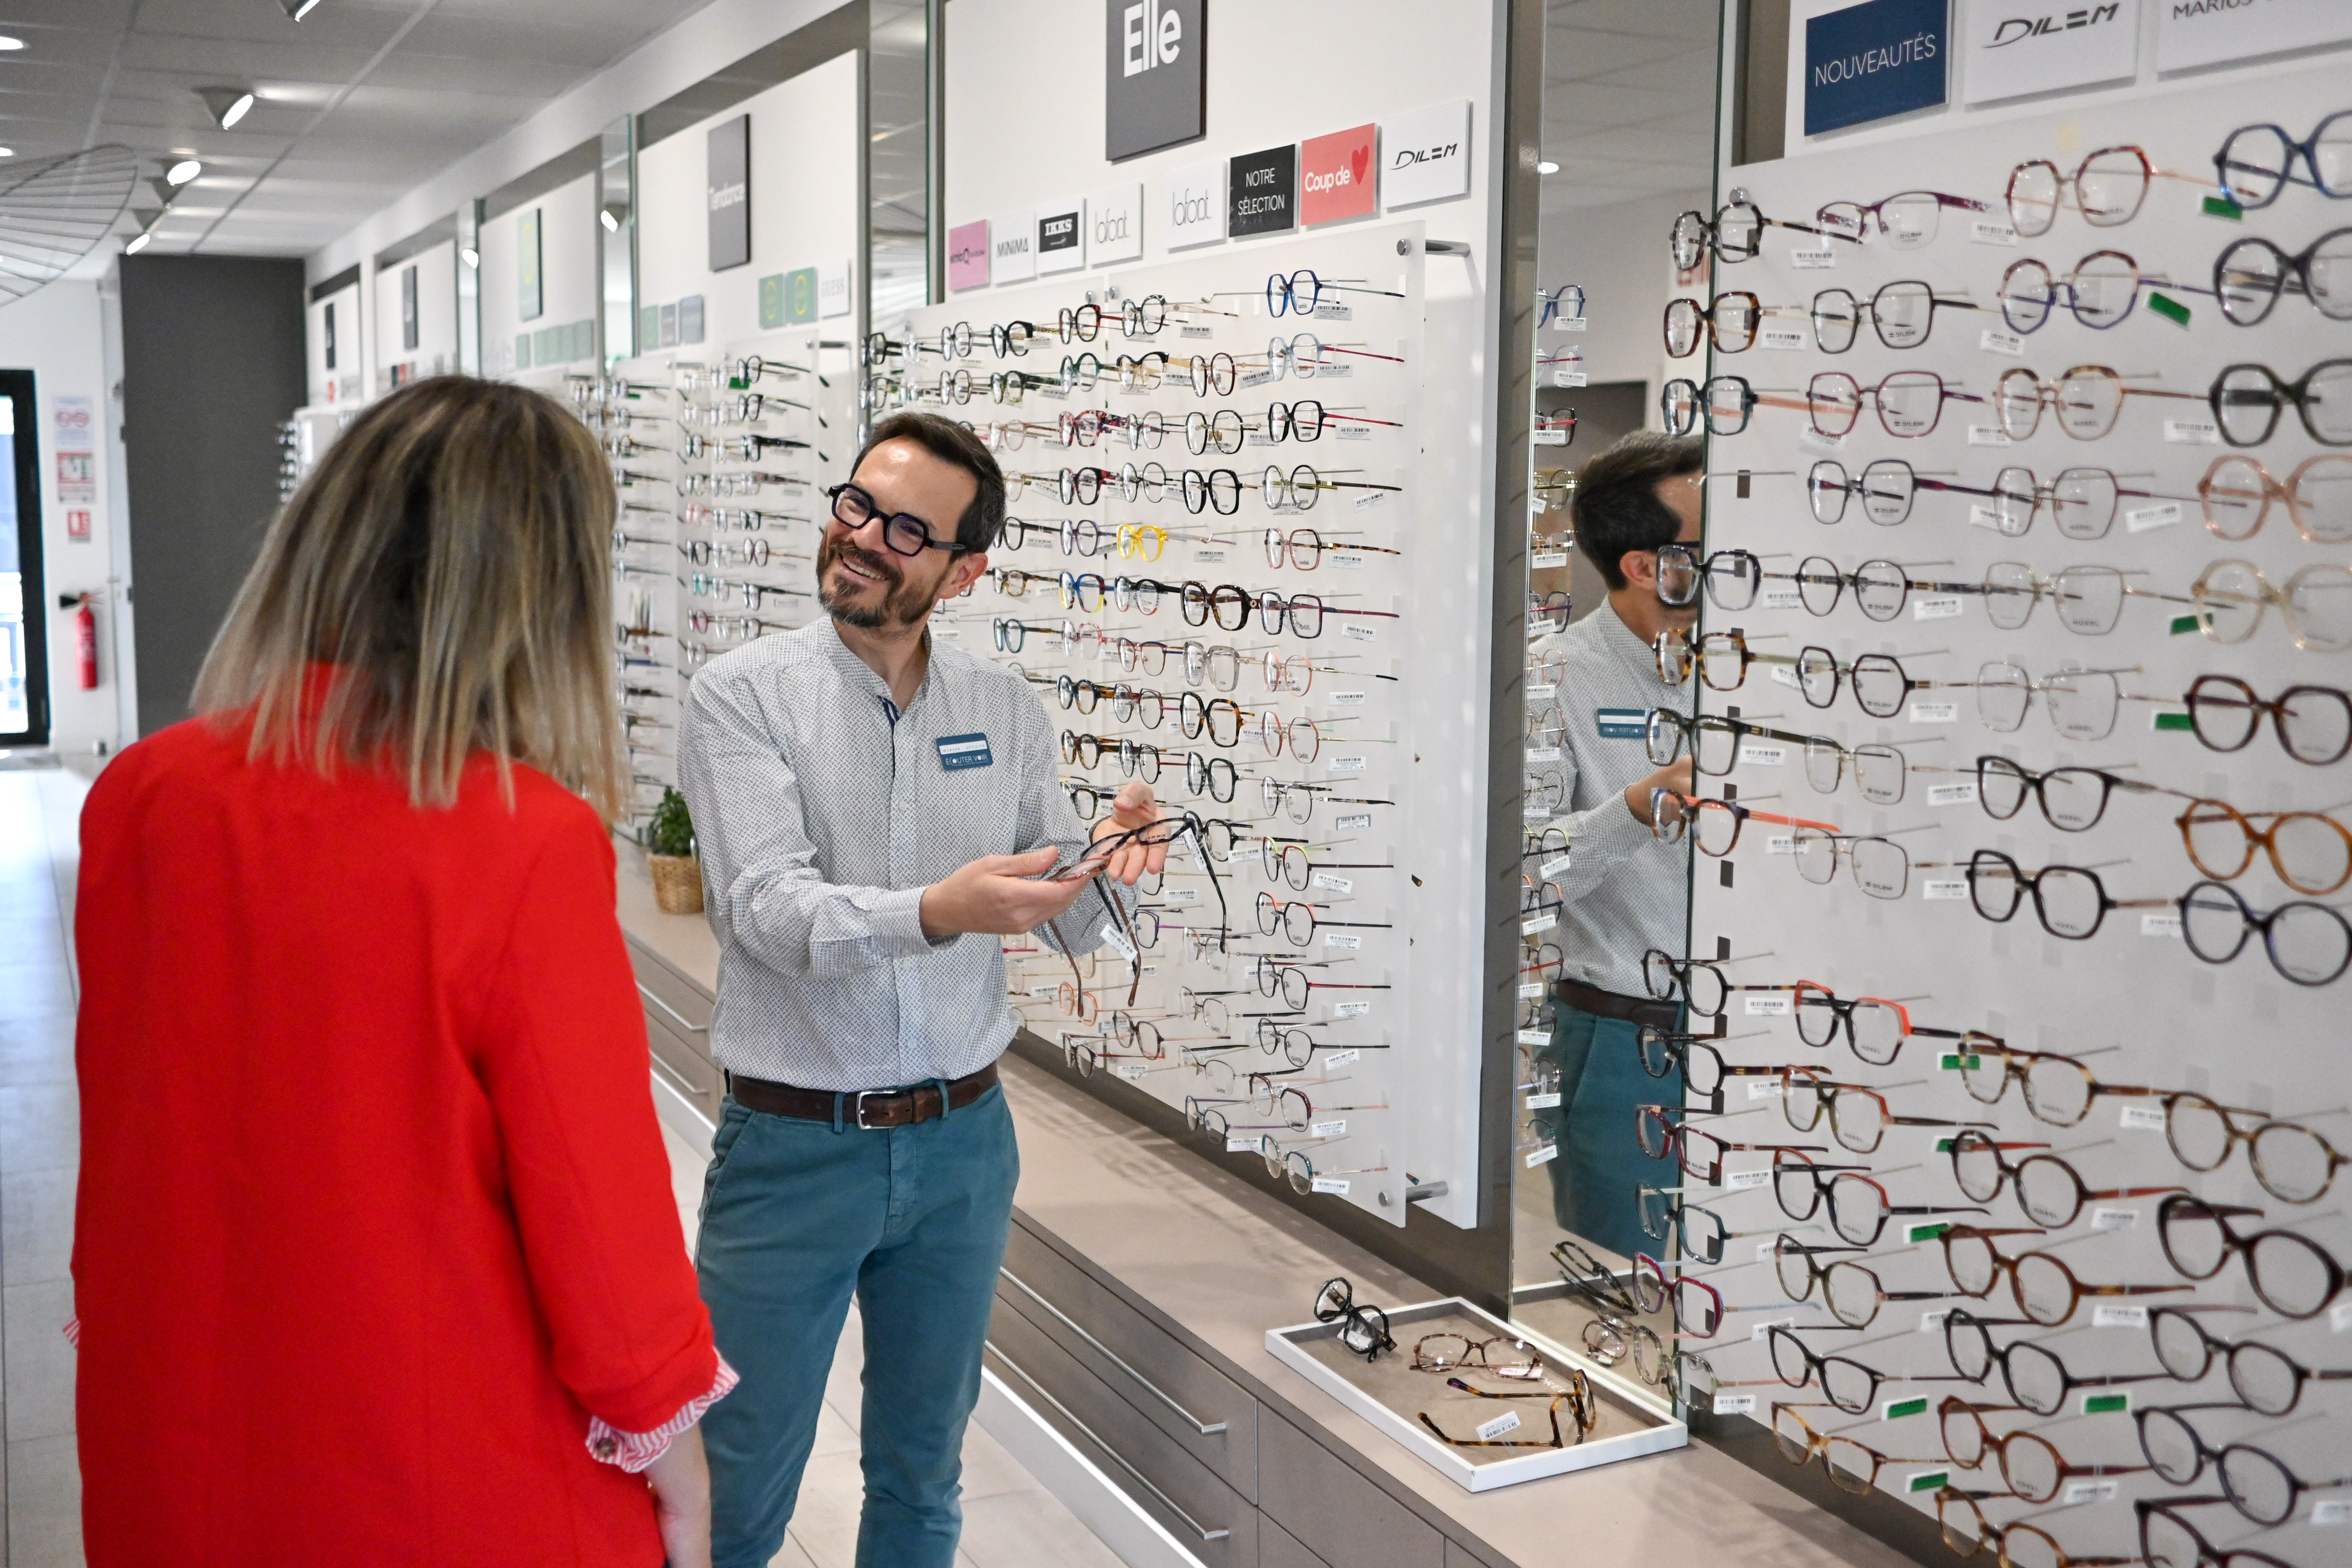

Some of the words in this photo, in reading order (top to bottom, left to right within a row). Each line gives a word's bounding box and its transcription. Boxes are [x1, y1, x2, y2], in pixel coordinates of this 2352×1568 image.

[1124, 0, 1181, 78] Elle
[1982, 2, 2120, 49] DILEM
[1815, 32, 1936, 87] NOUVEAUTÉS
[1390, 143, 1458, 170] DILEM
[1245, 167, 1275, 188] NOTRE
[1304, 172, 1334, 193] Coup
[1335, 165, 1351, 186] de
[1238, 193, 1285, 216] SÉLECTION
[1044, 218, 1073, 237] IKKS
[1538, 1377, 1566, 1393] OREL
